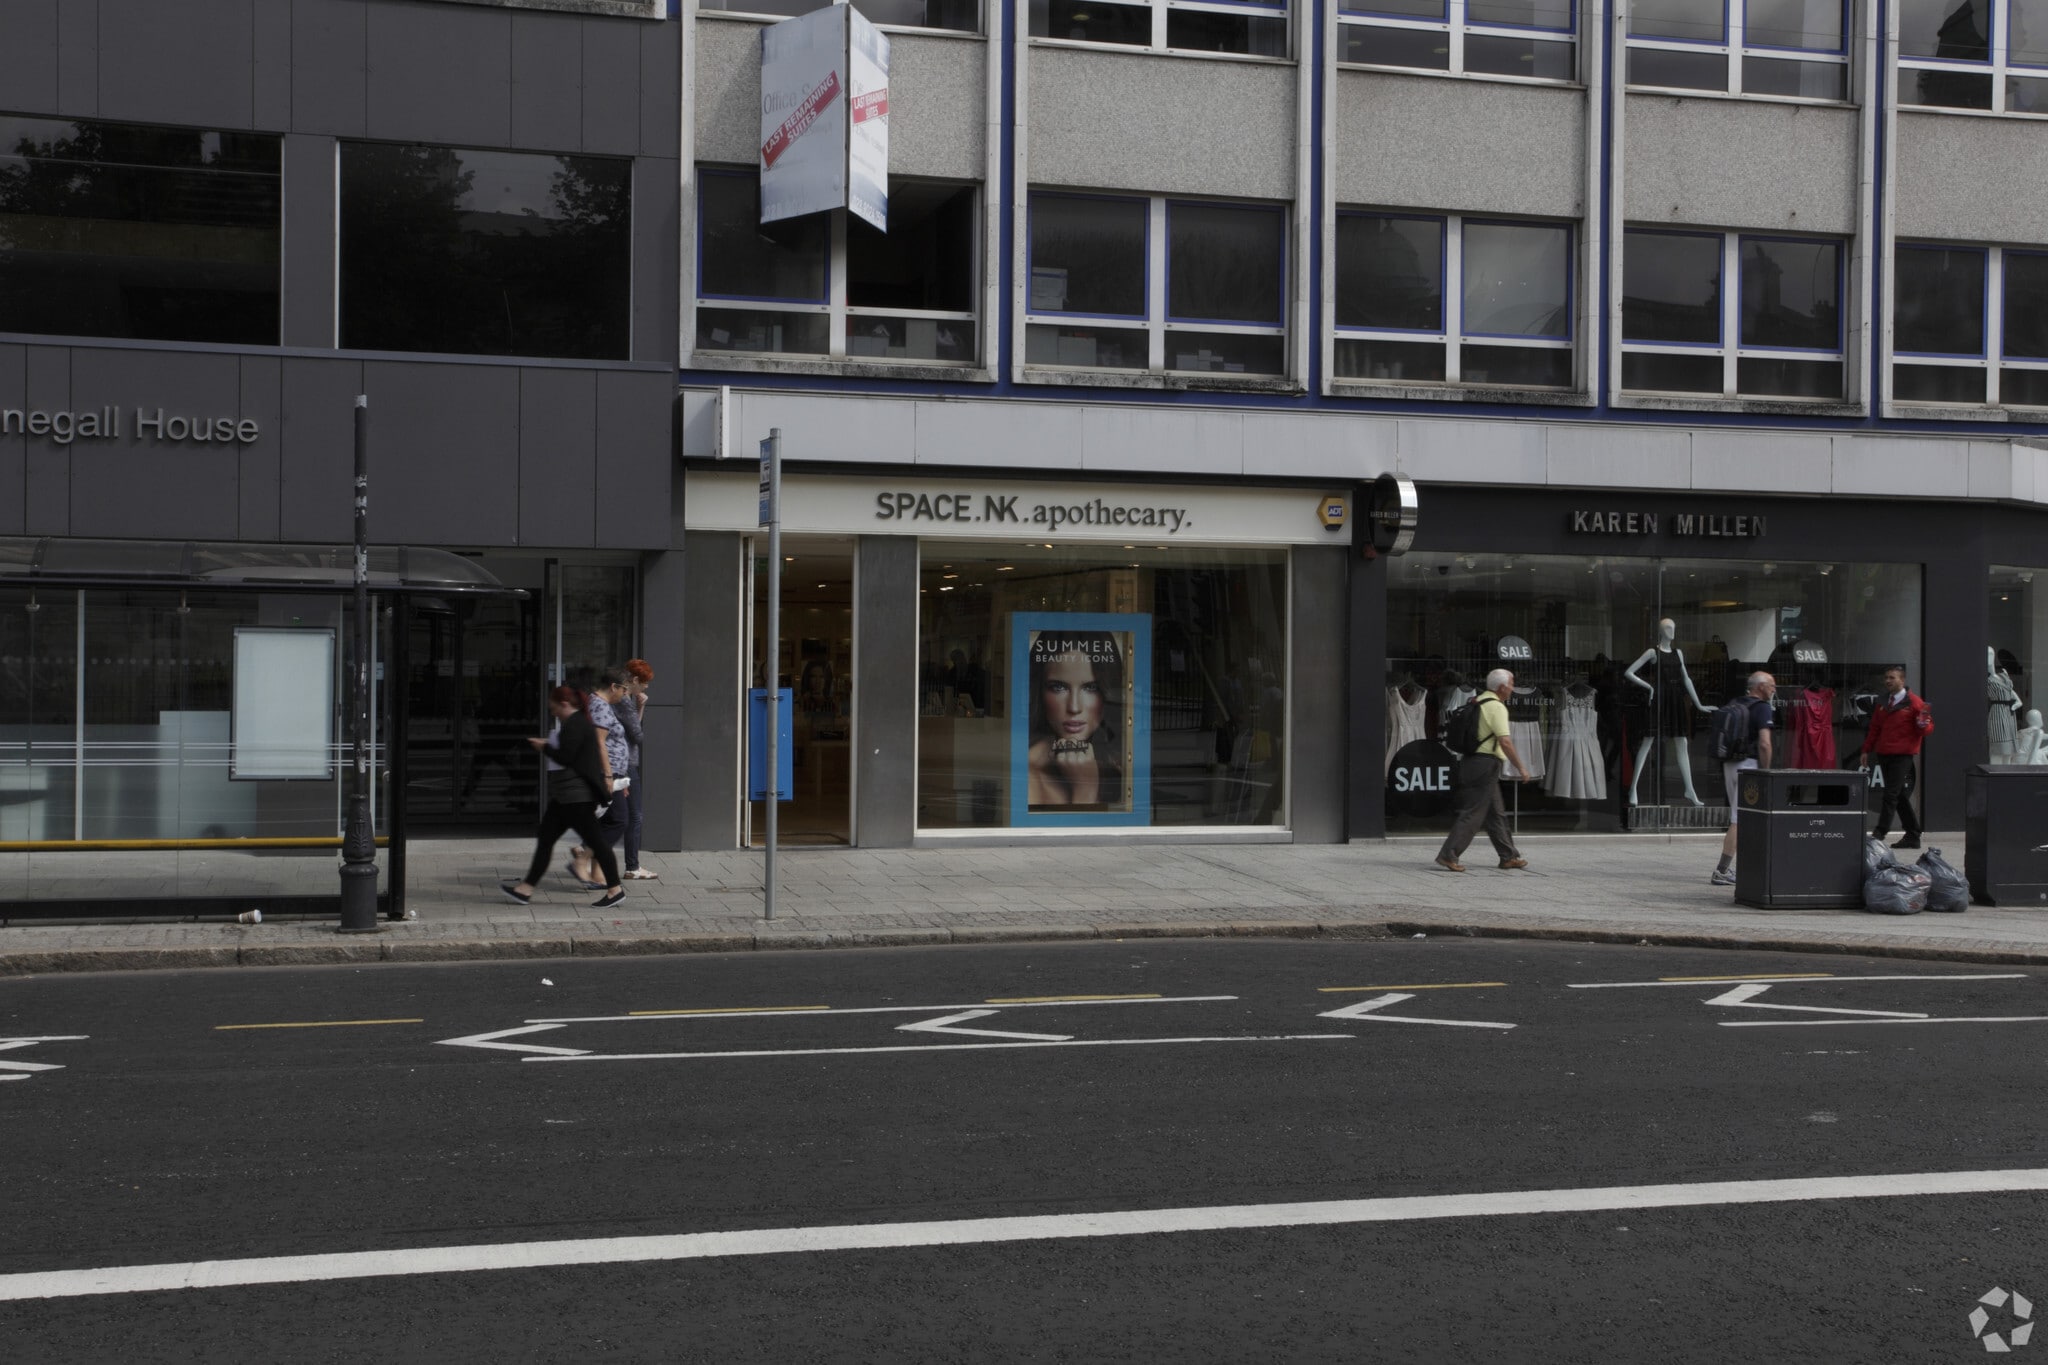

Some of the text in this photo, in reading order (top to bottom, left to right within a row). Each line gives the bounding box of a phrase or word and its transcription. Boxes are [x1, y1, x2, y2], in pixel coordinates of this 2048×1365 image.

[764, 91, 797, 115] Office
[765, 127, 784, 154] LAST
[784, 75, 834, 132] REMAINING
[786, 110, 818, 144] SUITES
[136, 407, 259, 443] House
[1328, 507, 1343, 516] ADT
[1573, 510, 1768, 537] KAREN MILLEN
[1035, 639, 1114, 653] SUMMER
[1499, 645, 1531, 659] SALE
[1795, 649, 1825, 662] SALE
[1035, 654, 1115, 664] BEAUTY ICONS
[1523, 697, 1556, 706] MILLEN
[1394, 766, 1451, 793] SALE
